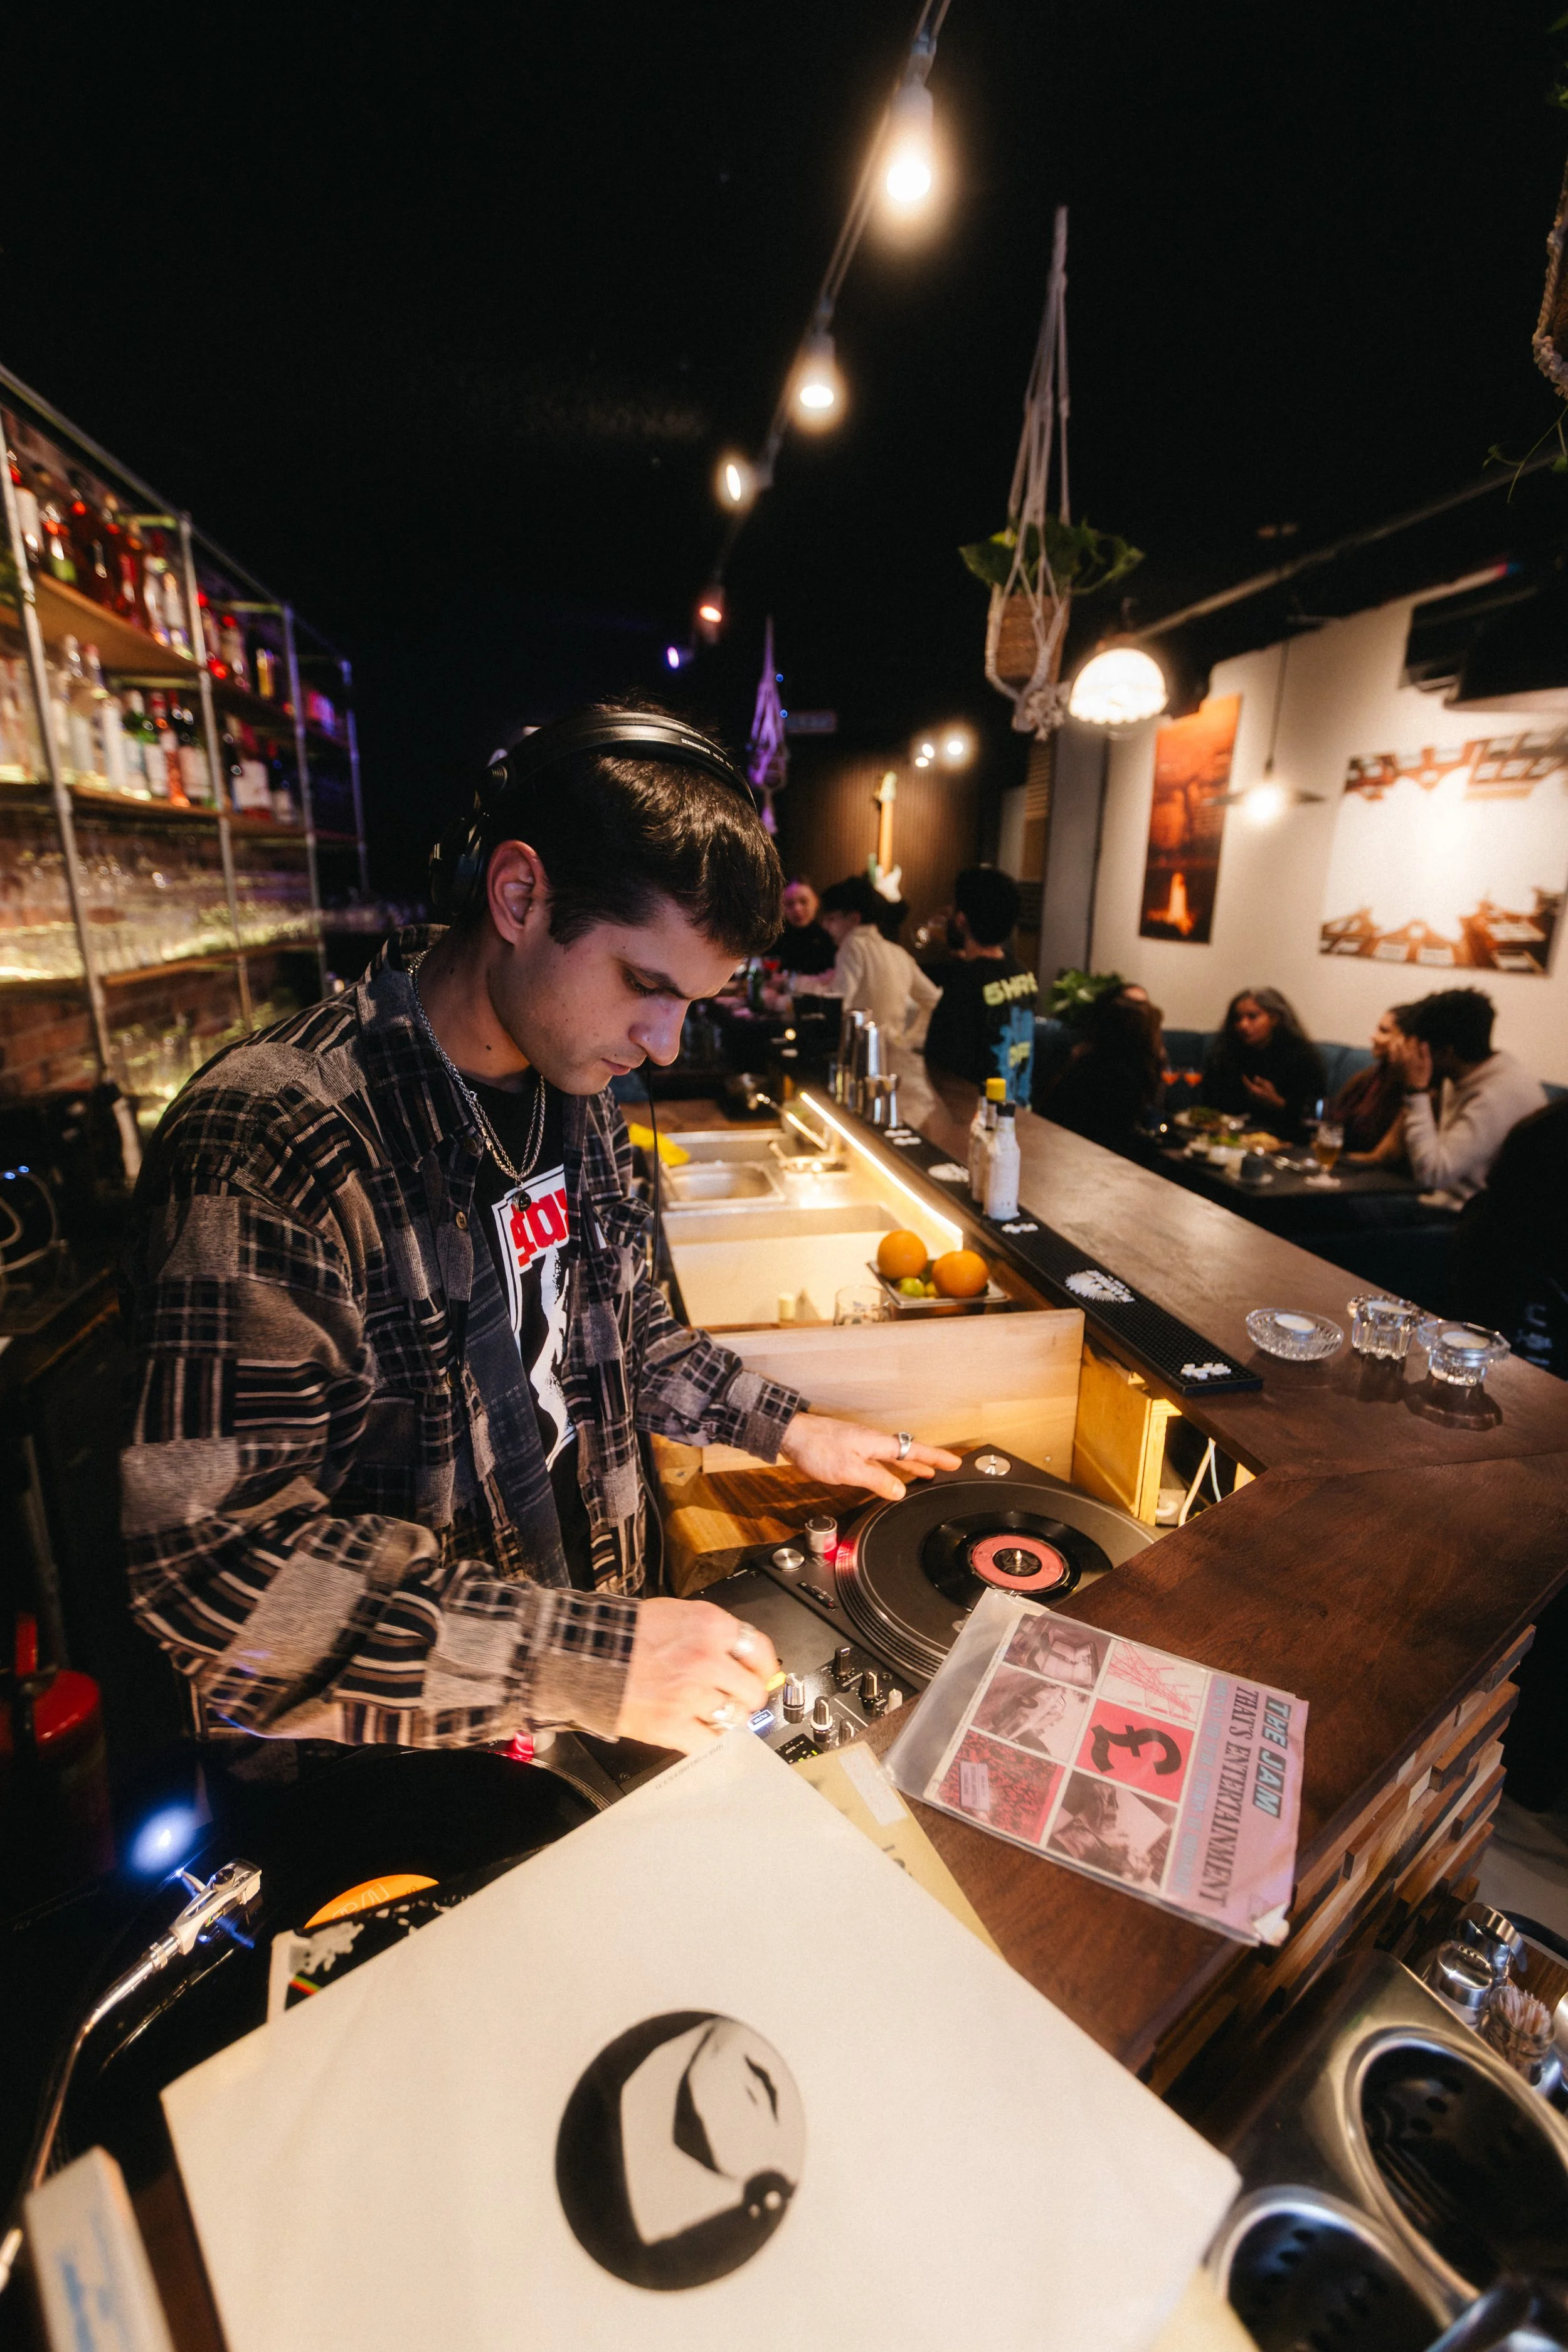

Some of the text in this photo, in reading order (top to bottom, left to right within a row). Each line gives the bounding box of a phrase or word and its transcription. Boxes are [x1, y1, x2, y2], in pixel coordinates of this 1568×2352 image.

[681, 738, 711, 754] SENNHEISER
[1229, 1687, 1258, 1740] THAT'S
[1253, 1695, 1291, 1820] THE JAM
[1199, 1742, 1252, 1907] ENTERTAINMENT
